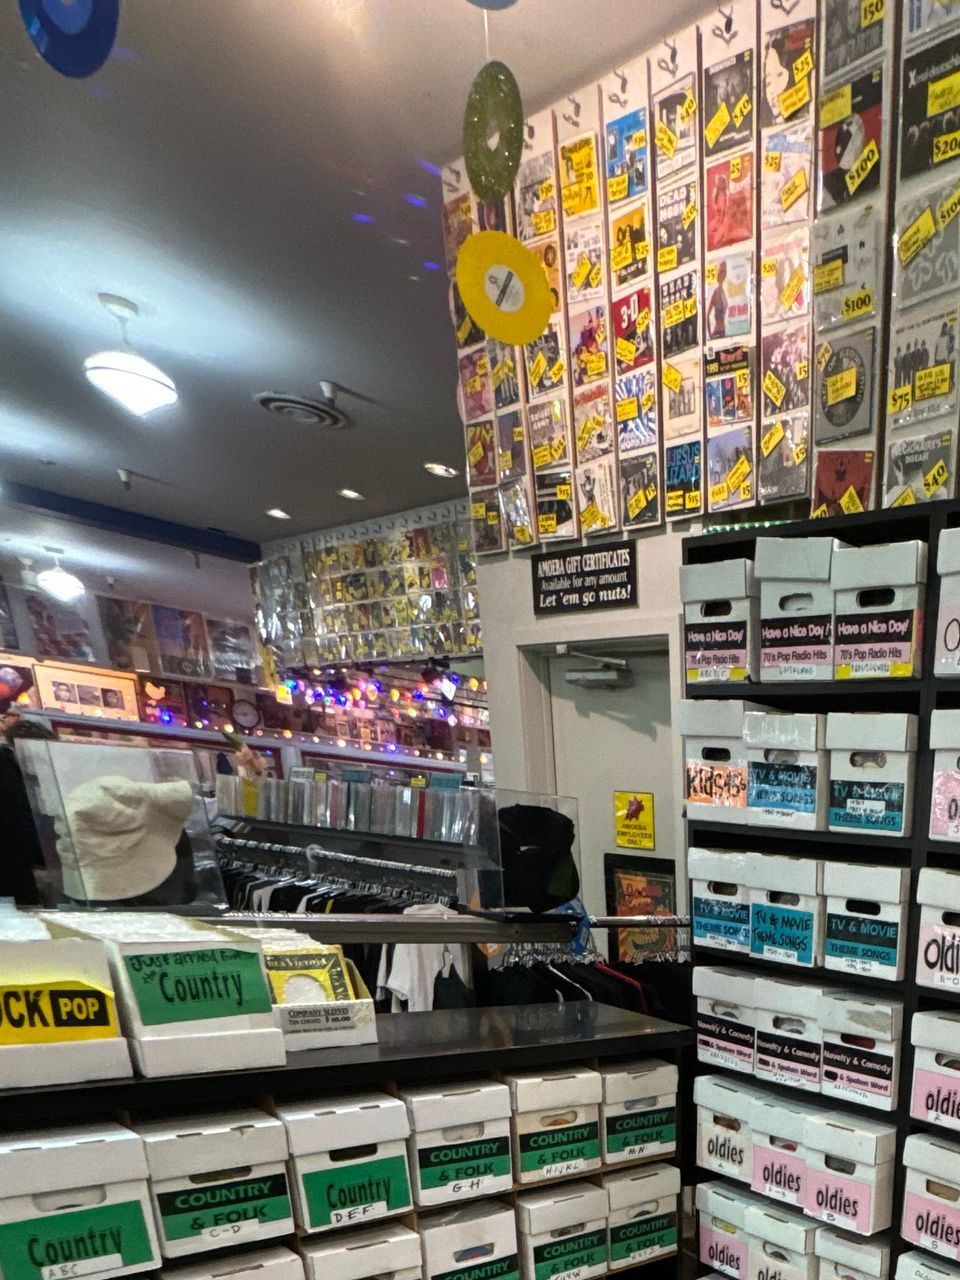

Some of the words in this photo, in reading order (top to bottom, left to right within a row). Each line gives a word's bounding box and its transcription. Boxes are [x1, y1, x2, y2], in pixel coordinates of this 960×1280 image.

[848, 149, 876, 184] $100
[845, 295, 872, 311] $100
[892, 393, 909, 408] $75
[924, 465, 945, 492] $40
[538, 561, 564, 577] AMOEBA
[566, 556, 581, 573] GIFT
[582, 549, 630, 570] CERTIFICATES
[541, 577, 570, 591] Available
[573, 575, 583, 588] for
[584, 575, 597, 589] any
[599, 571, 627, 583] amount
[540, 595, 556, 607] Let
[582, 591, 595, 606] go
[600, 585, 631, 601] nuts!
[838, 622, 859, 635] Have
[861, 624, 867, 634] a
[869, 621, 887, 634] Nice
[840, 651, 853, 661] 70's
[854, 650, 867, 661] Pop
[868, 649, 888, 660] Radio
[889, 648, 902, 659] Hits
[618, 831, 652, 839] EMPLOYEES
[831, 919, 846, 930] TV
[849, 920, 856, 932] &
[861, 922, 897, 938] MOVIE
[831, 944, 861, 954] THEME
[863, 948, 890, 960] SONGS
[159, 971, 243, 1005] Country
[59, 999, 100, 1021] POP
[288, 1009, 321, 1018] COMPANY
[757, 1039, 782, 1053] Novelty
[783, 1045, 790, 1054] &
[792, 1047, 821, 1061] Comedy
[777, 1063, 799, 1075] Spoken
[799, 1068, 817, 1078] Word
[824, 1050, 851, 1065] Novelty
[853, 1057, 859, 1065] &
[861, 1059, 893, 1073] Comedy
[845, 1074, 869, 1088] Spoken
[870, 1080, 889, 1091] Word
[529, 1127, 589, 1148] COUNTRY
[175, 1178, 273, 1209] COUNTRY
[326, 1176, 392, 1210] Country
[816, 1185, 858, 1217] oldies
[190, 1217, 204, 1231] &
[213, 1204, 267, 1224] FOLK
[209, 1224, 241, 1238] C-D
[28, 1226, 122, 1268] Country
